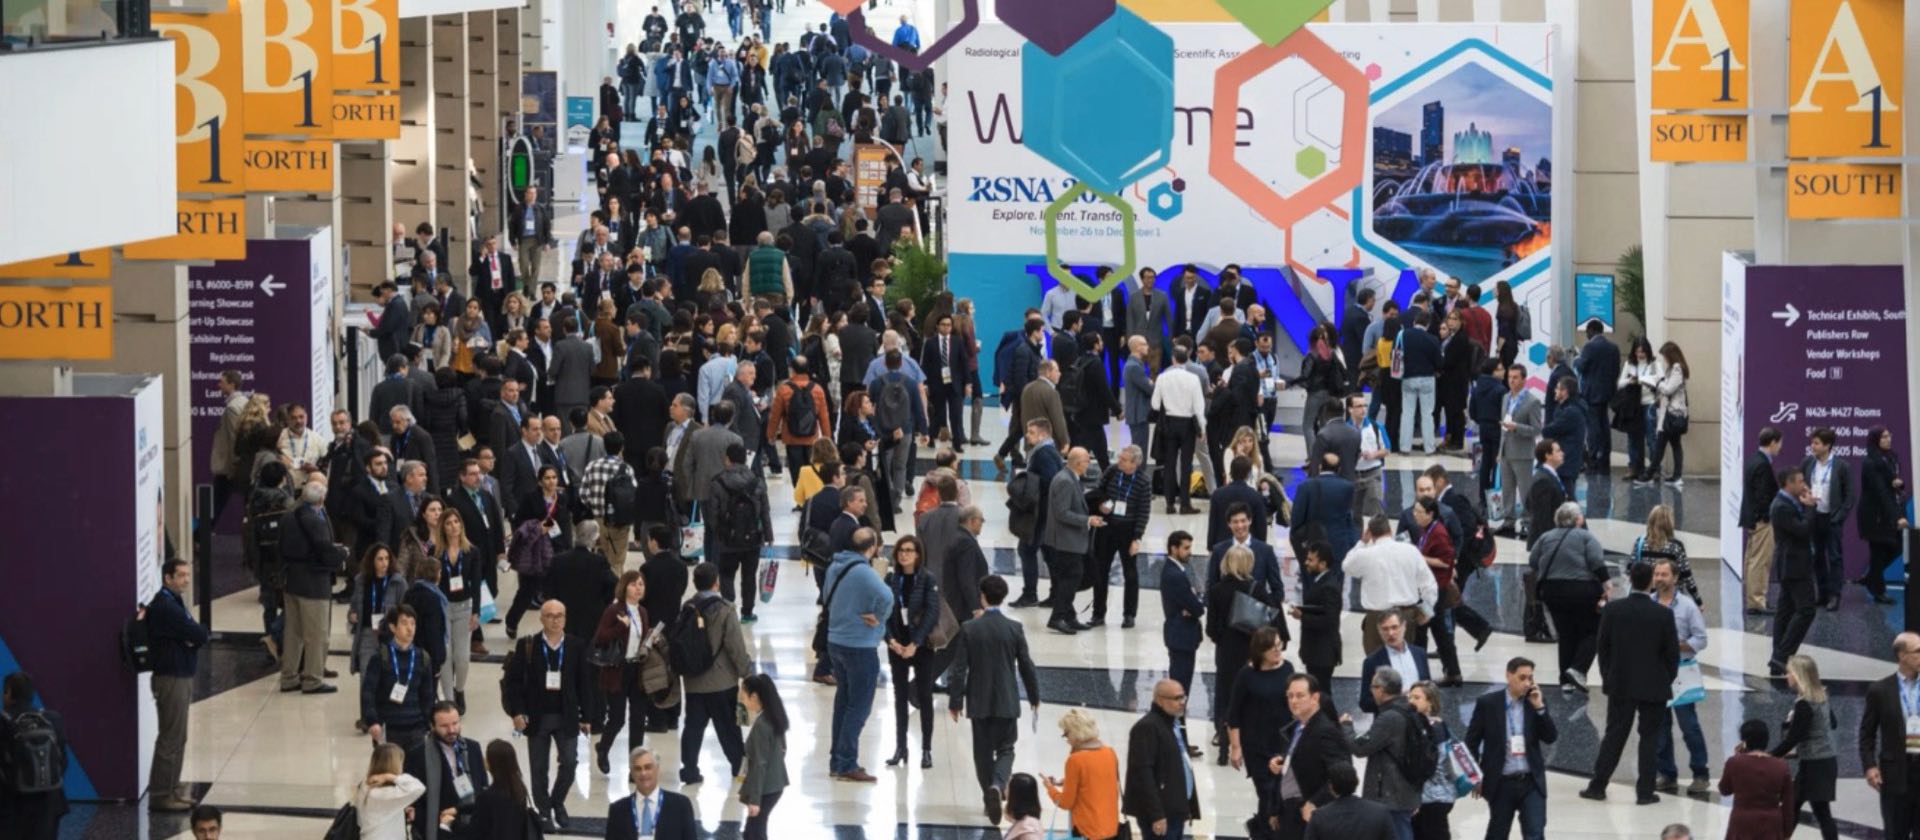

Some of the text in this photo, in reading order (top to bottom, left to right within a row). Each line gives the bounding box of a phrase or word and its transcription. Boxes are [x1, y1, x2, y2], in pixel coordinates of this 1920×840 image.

[965, 47, 1019, 58] Radiological
[1174, 49, 1215, 59] Scientific
[1652, 0, 1745, 102] A 1
[240, 0, 322, 128] B 1
[1789, 0, 1899, 148] A 1
[332, 104, 395, 121] ORTH
[1656, 123, 1742, 143] SOUTH
[197, 115, 232, 184] 1
[967, 176, 1055, 203] RSNA
[1794, 173, 1895, 196] SOUTH
[992, 208, 1037, 222] Explore.
[177, 212, 238, 234] RTH
[1080, 226, 1094, 236] 26
[1095, 227, 1105, 237] to
[216, 297, 255, 309] Showcase
[0, 300, 102, 329] ORTH
[1807, 309, 1845, 321] Technical
[1846, 310, 1882, 321] Exhibits,
[216, 316, 255, 327] Showcase
[224, 334, 255, 344] Pavilion
[1806, 328, 1869, 340] Publishers Row
[209, 352, 255, 364] Registration
[1806, 349, 1880, 362] Vendor Workshops
[1805, 367, 1827, 379] Food
[1853, 407, 1881, 418] Rooms
